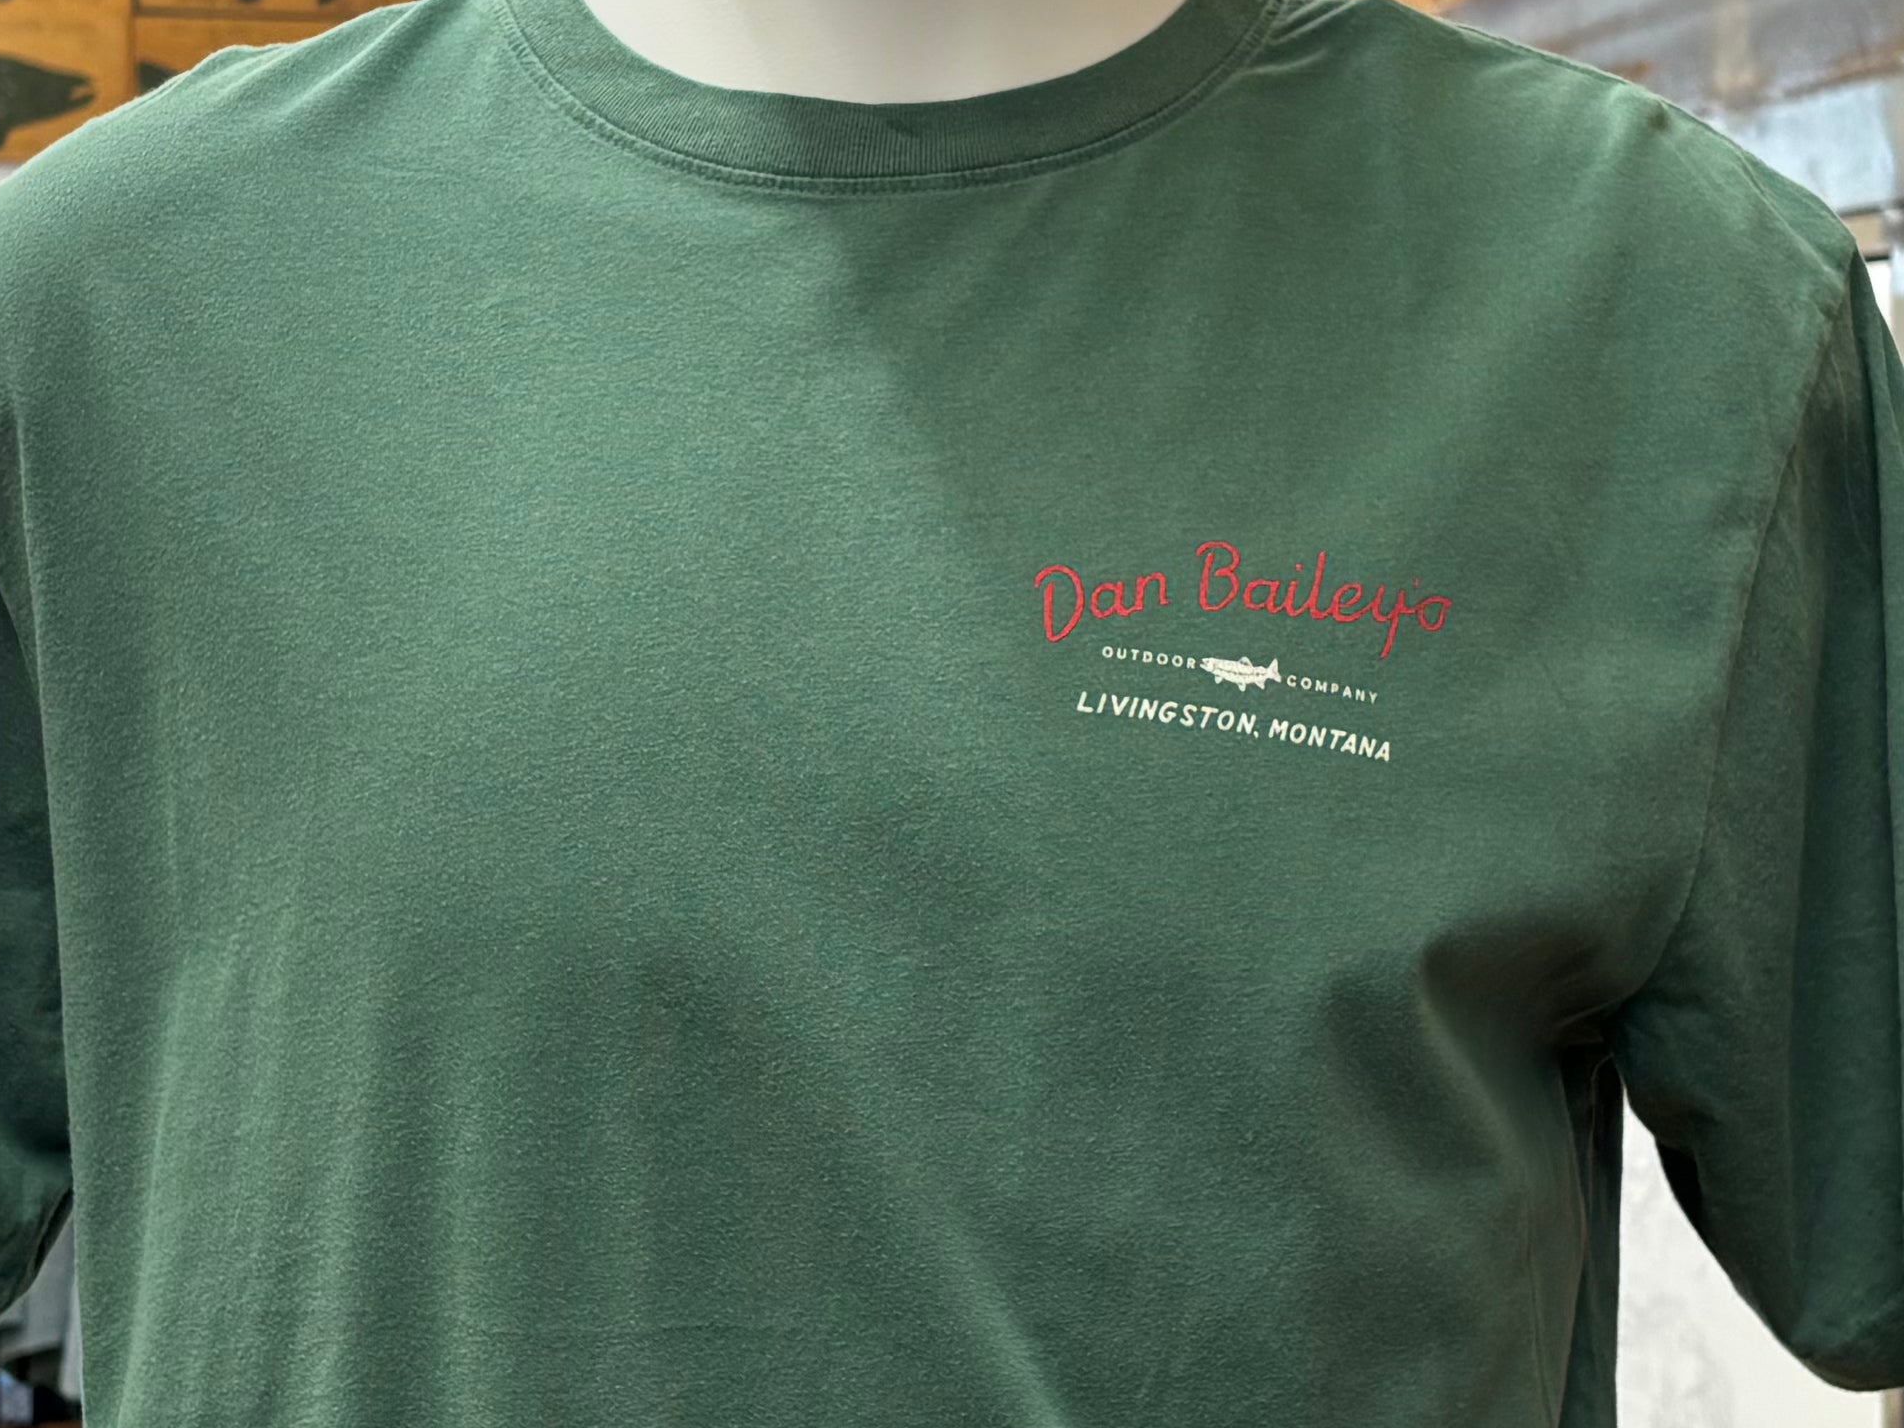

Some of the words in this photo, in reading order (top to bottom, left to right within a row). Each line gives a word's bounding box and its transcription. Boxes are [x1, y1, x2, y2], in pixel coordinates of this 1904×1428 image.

[1033, 563, 1170, 644] Dan
[1101, 645, 1197, 670] OUTDOOR
[1286, 674, 1379, 705] COMPANY
[1075, 690, 1260, 739] LIVINGSTON,
[1268, 719, 1392, 763] MONTANA
